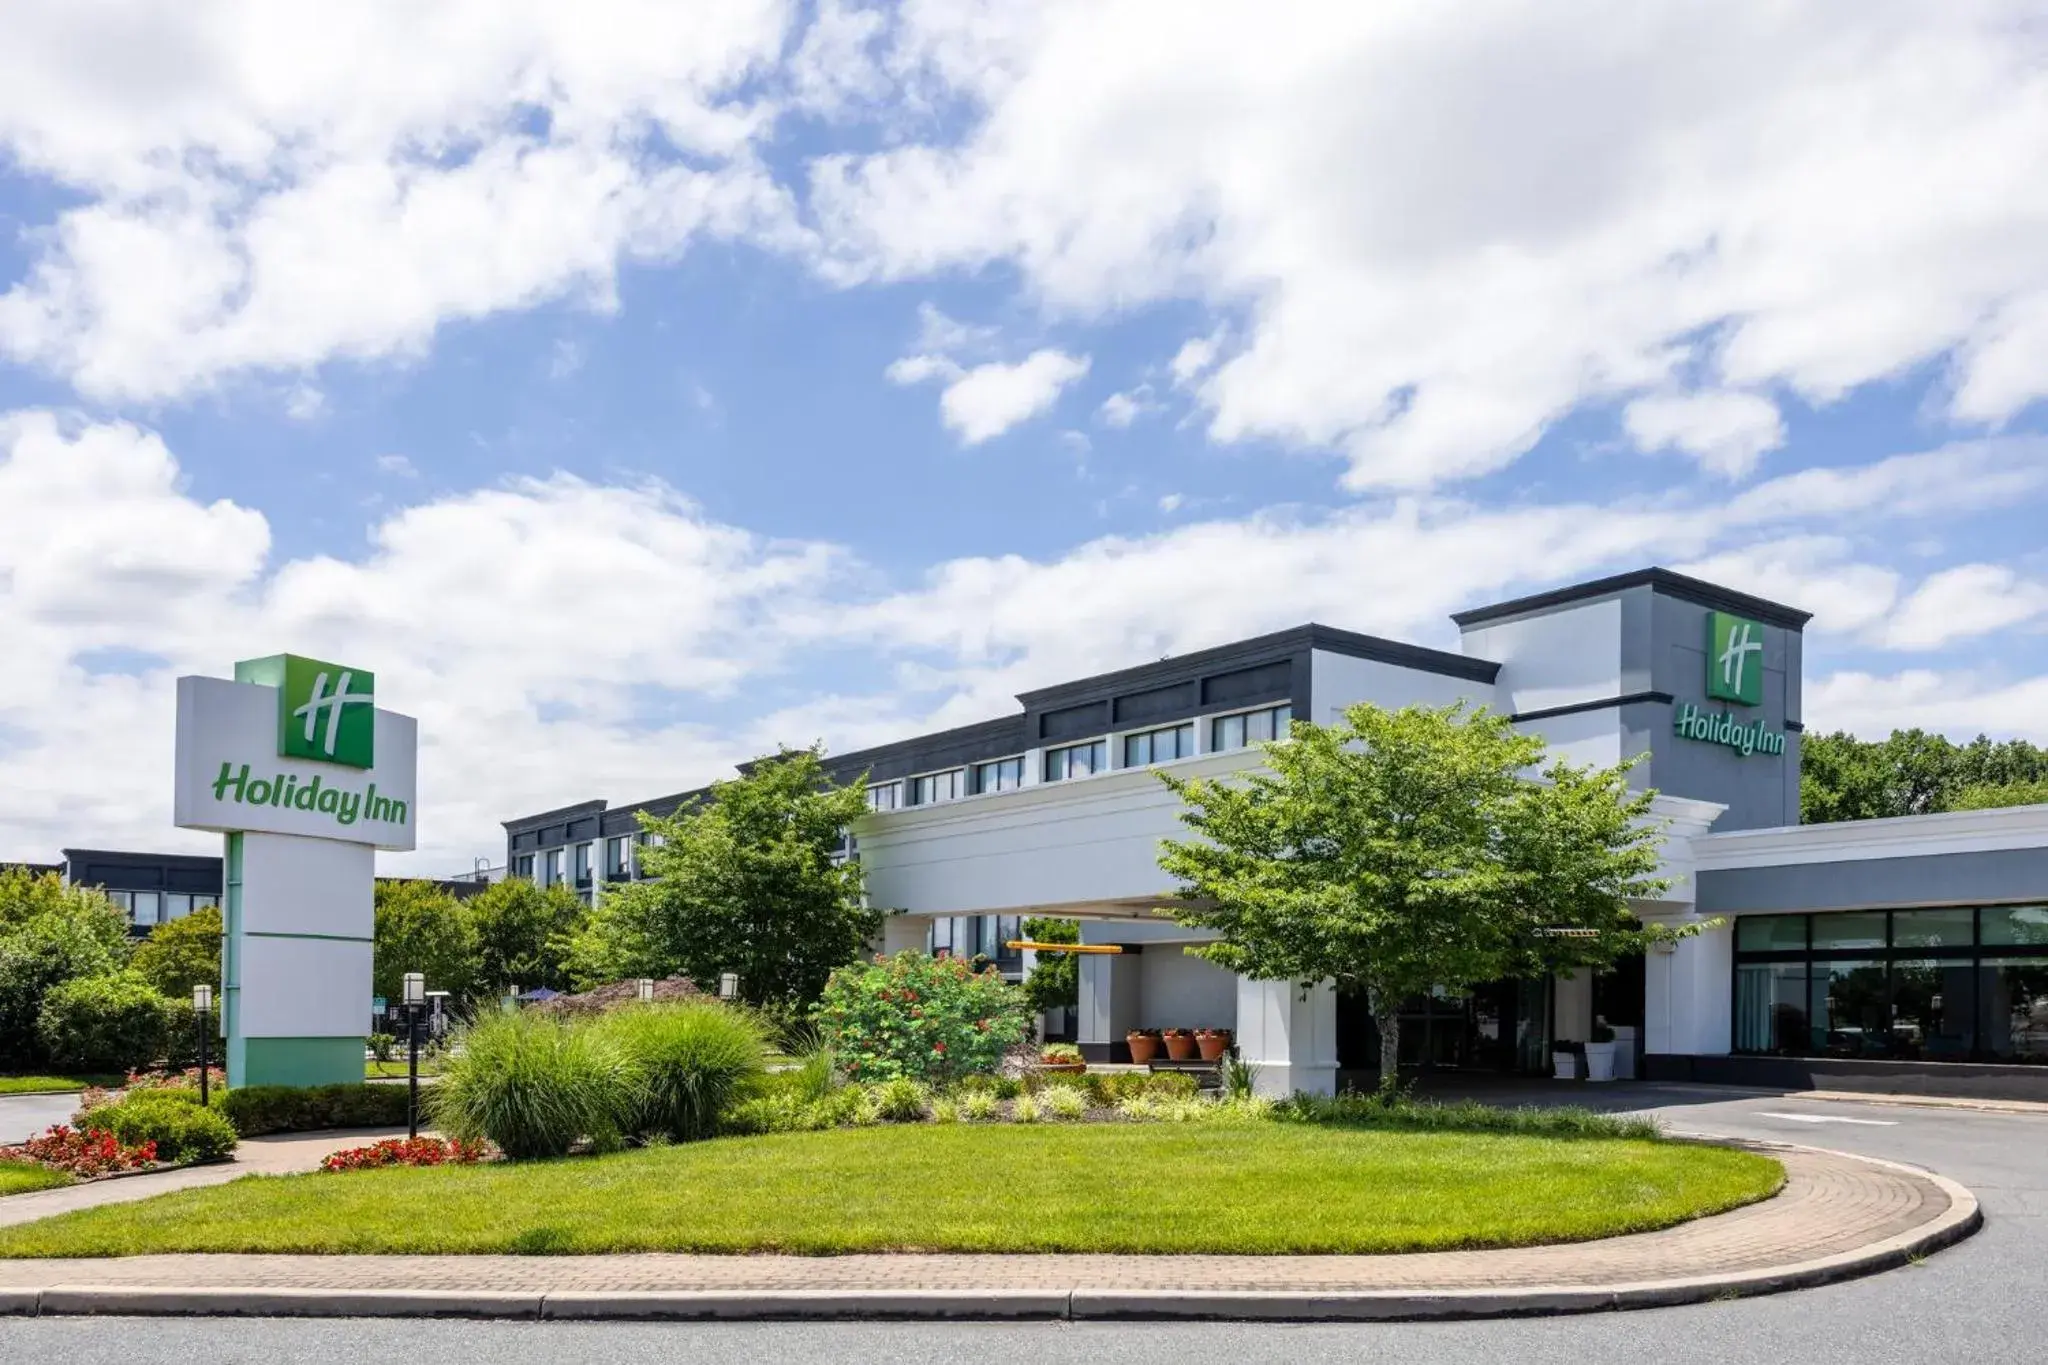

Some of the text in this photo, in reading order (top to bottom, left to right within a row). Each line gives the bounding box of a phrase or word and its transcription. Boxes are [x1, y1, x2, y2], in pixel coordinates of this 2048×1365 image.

[1679, 703, 1785, 756] Holiday Inn
[212, 762, 408, 825] Holiday Inn
